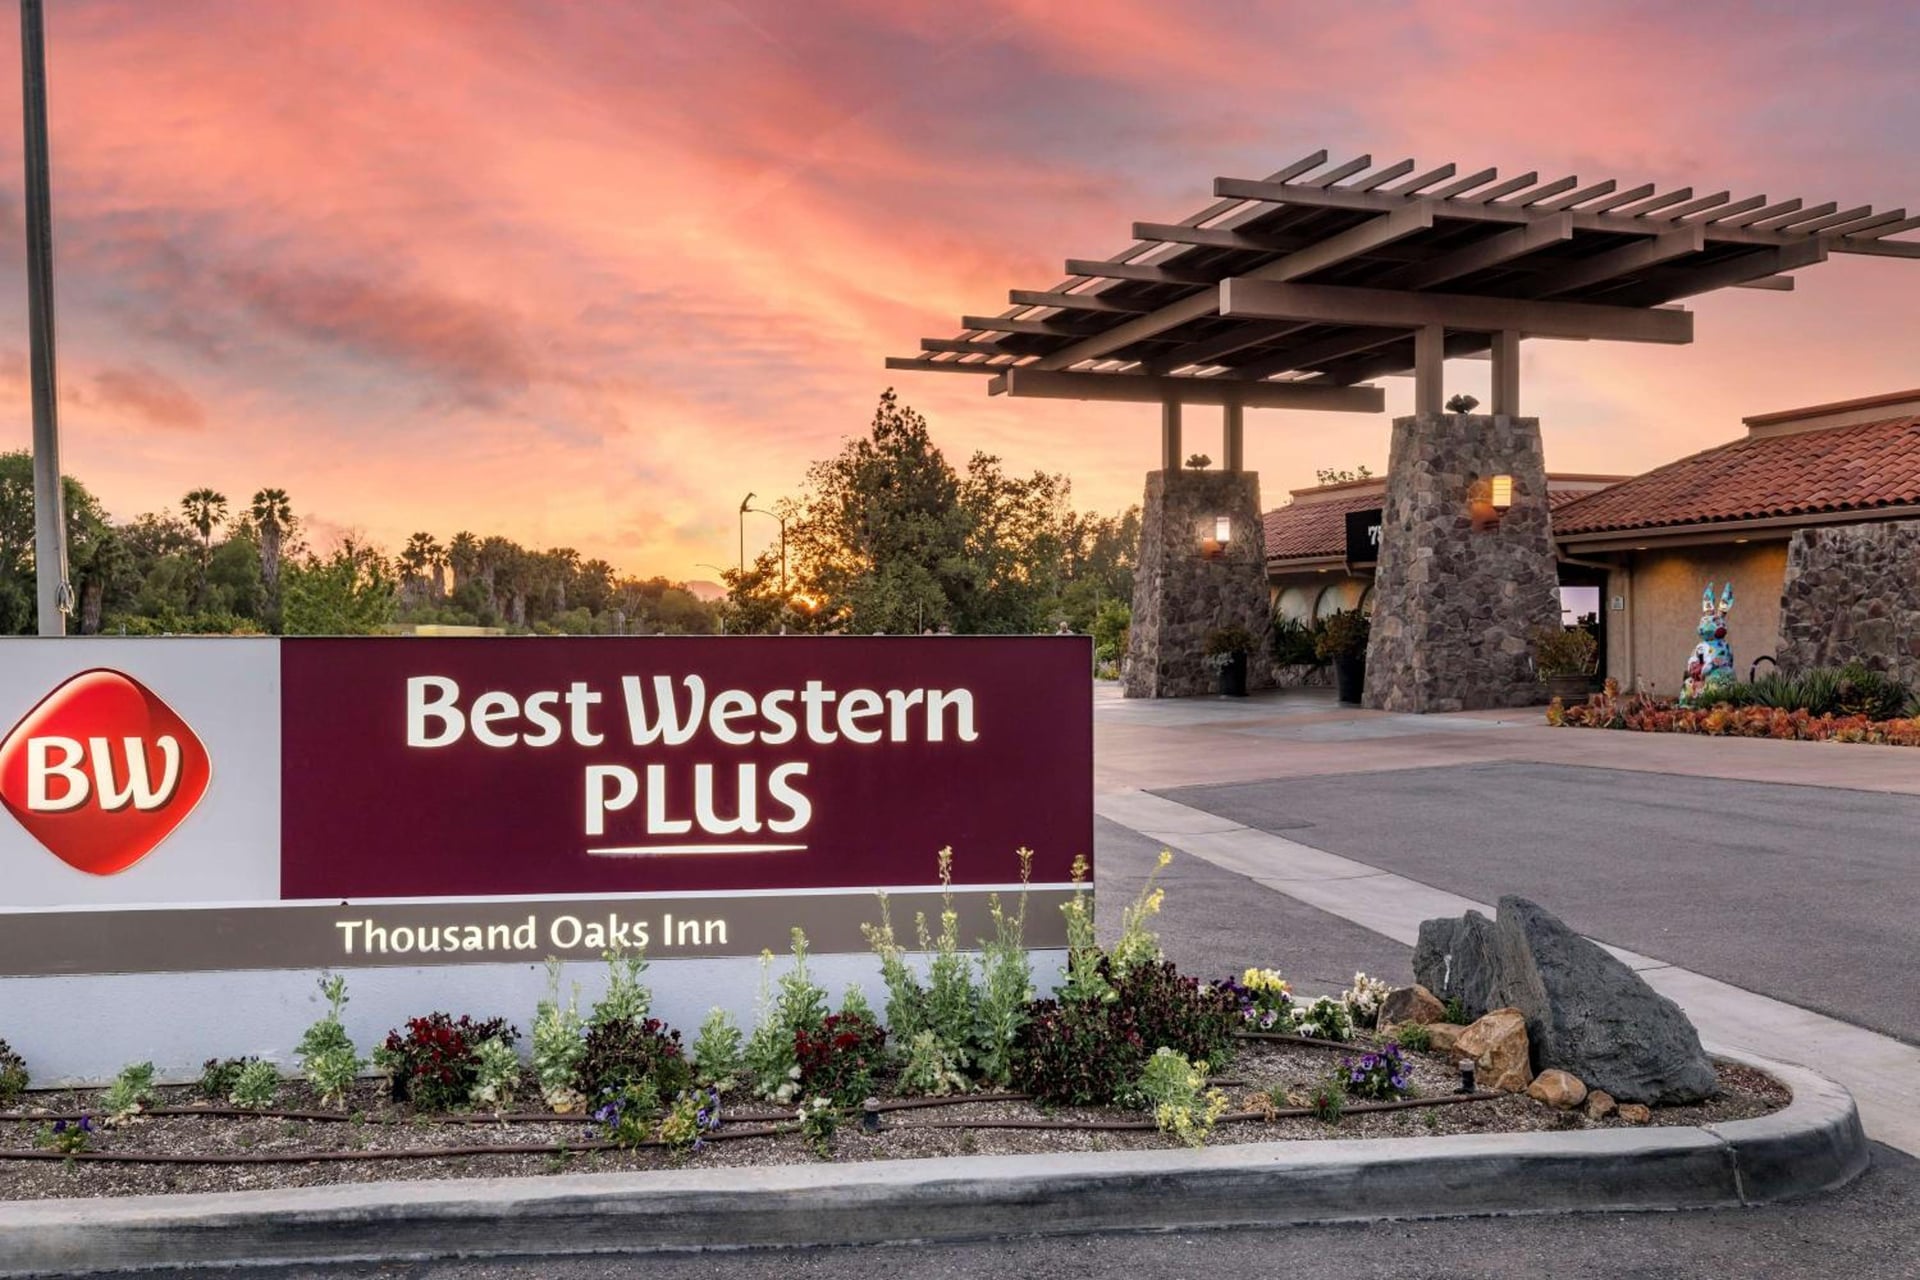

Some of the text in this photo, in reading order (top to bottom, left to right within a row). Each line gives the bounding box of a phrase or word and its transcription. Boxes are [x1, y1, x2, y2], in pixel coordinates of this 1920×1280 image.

[407, 674, 979, 748] Best Western
[27, 735, 182, 811] BW
[585, 762, 812, 835] PLUS
[335, 913, 728, 954] Thousand Oaks Inn
